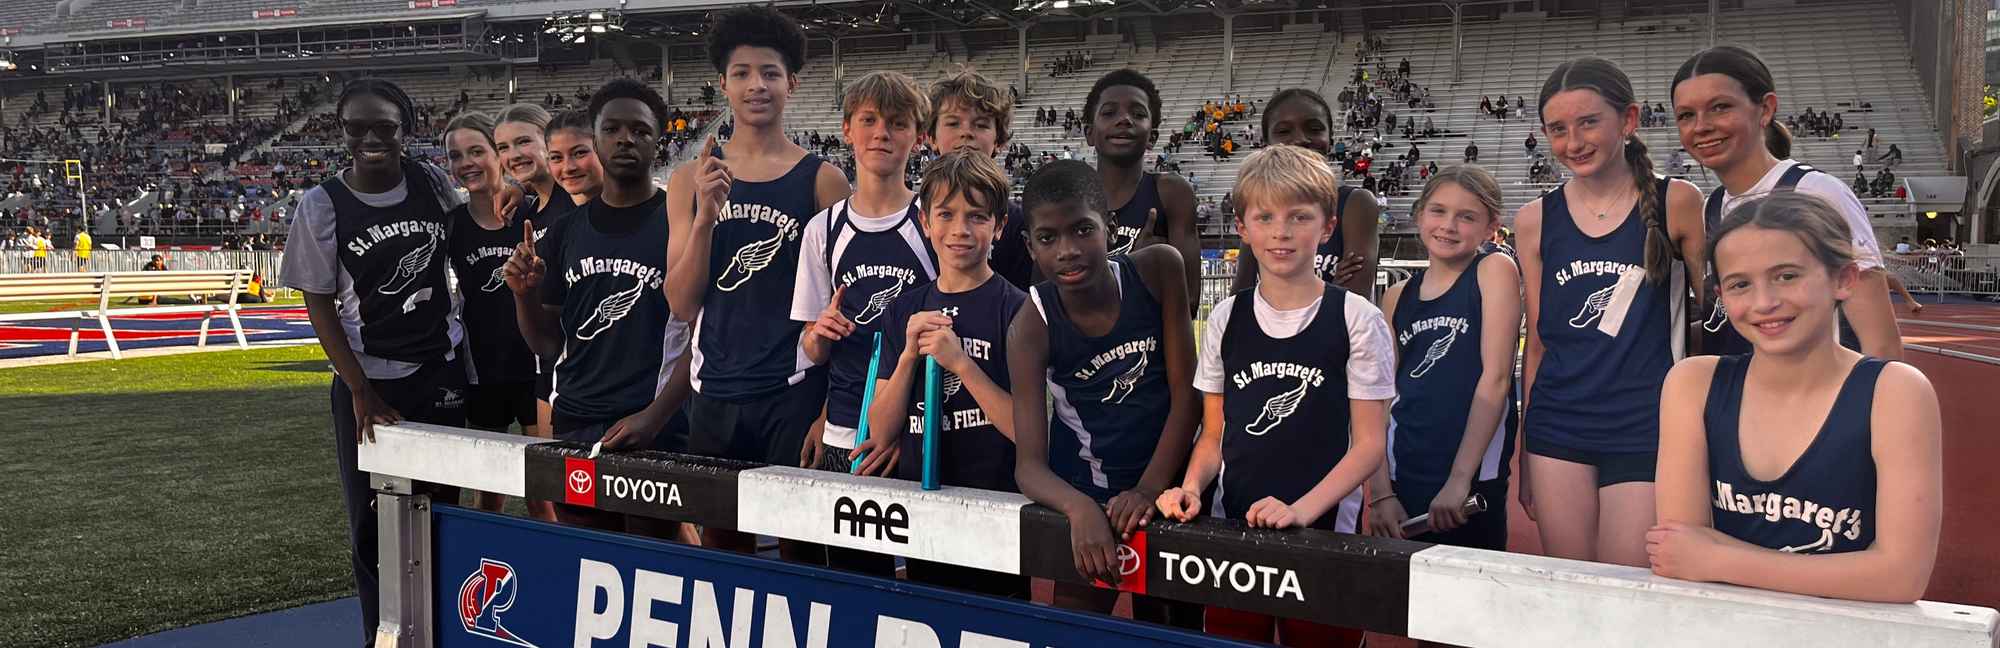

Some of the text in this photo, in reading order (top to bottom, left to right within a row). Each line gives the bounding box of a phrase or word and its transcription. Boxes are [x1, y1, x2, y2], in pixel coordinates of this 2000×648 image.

[718, 200, 800, 241] Margaret's
[347, 236, 373, 256] St.
[466, 246, 514, 265] St. Margar
[579, 256, 663, 289] Margaret's
[842, 264, 917, 287] St. Margaret's
[1556, 260, 1637, 286] St. Margare
[1400, 316, 1469, 346] St. Margaret's
[1074, 336, 1157, 380] St. Margaret's
[1233, 361, 1325, 390] St. Margaret's
[602, 474, 682, 507] TOYOTA
[1715, 480, 1862, 541] Margaret's
[1159, 551, 1305, 602] TOYOTA
